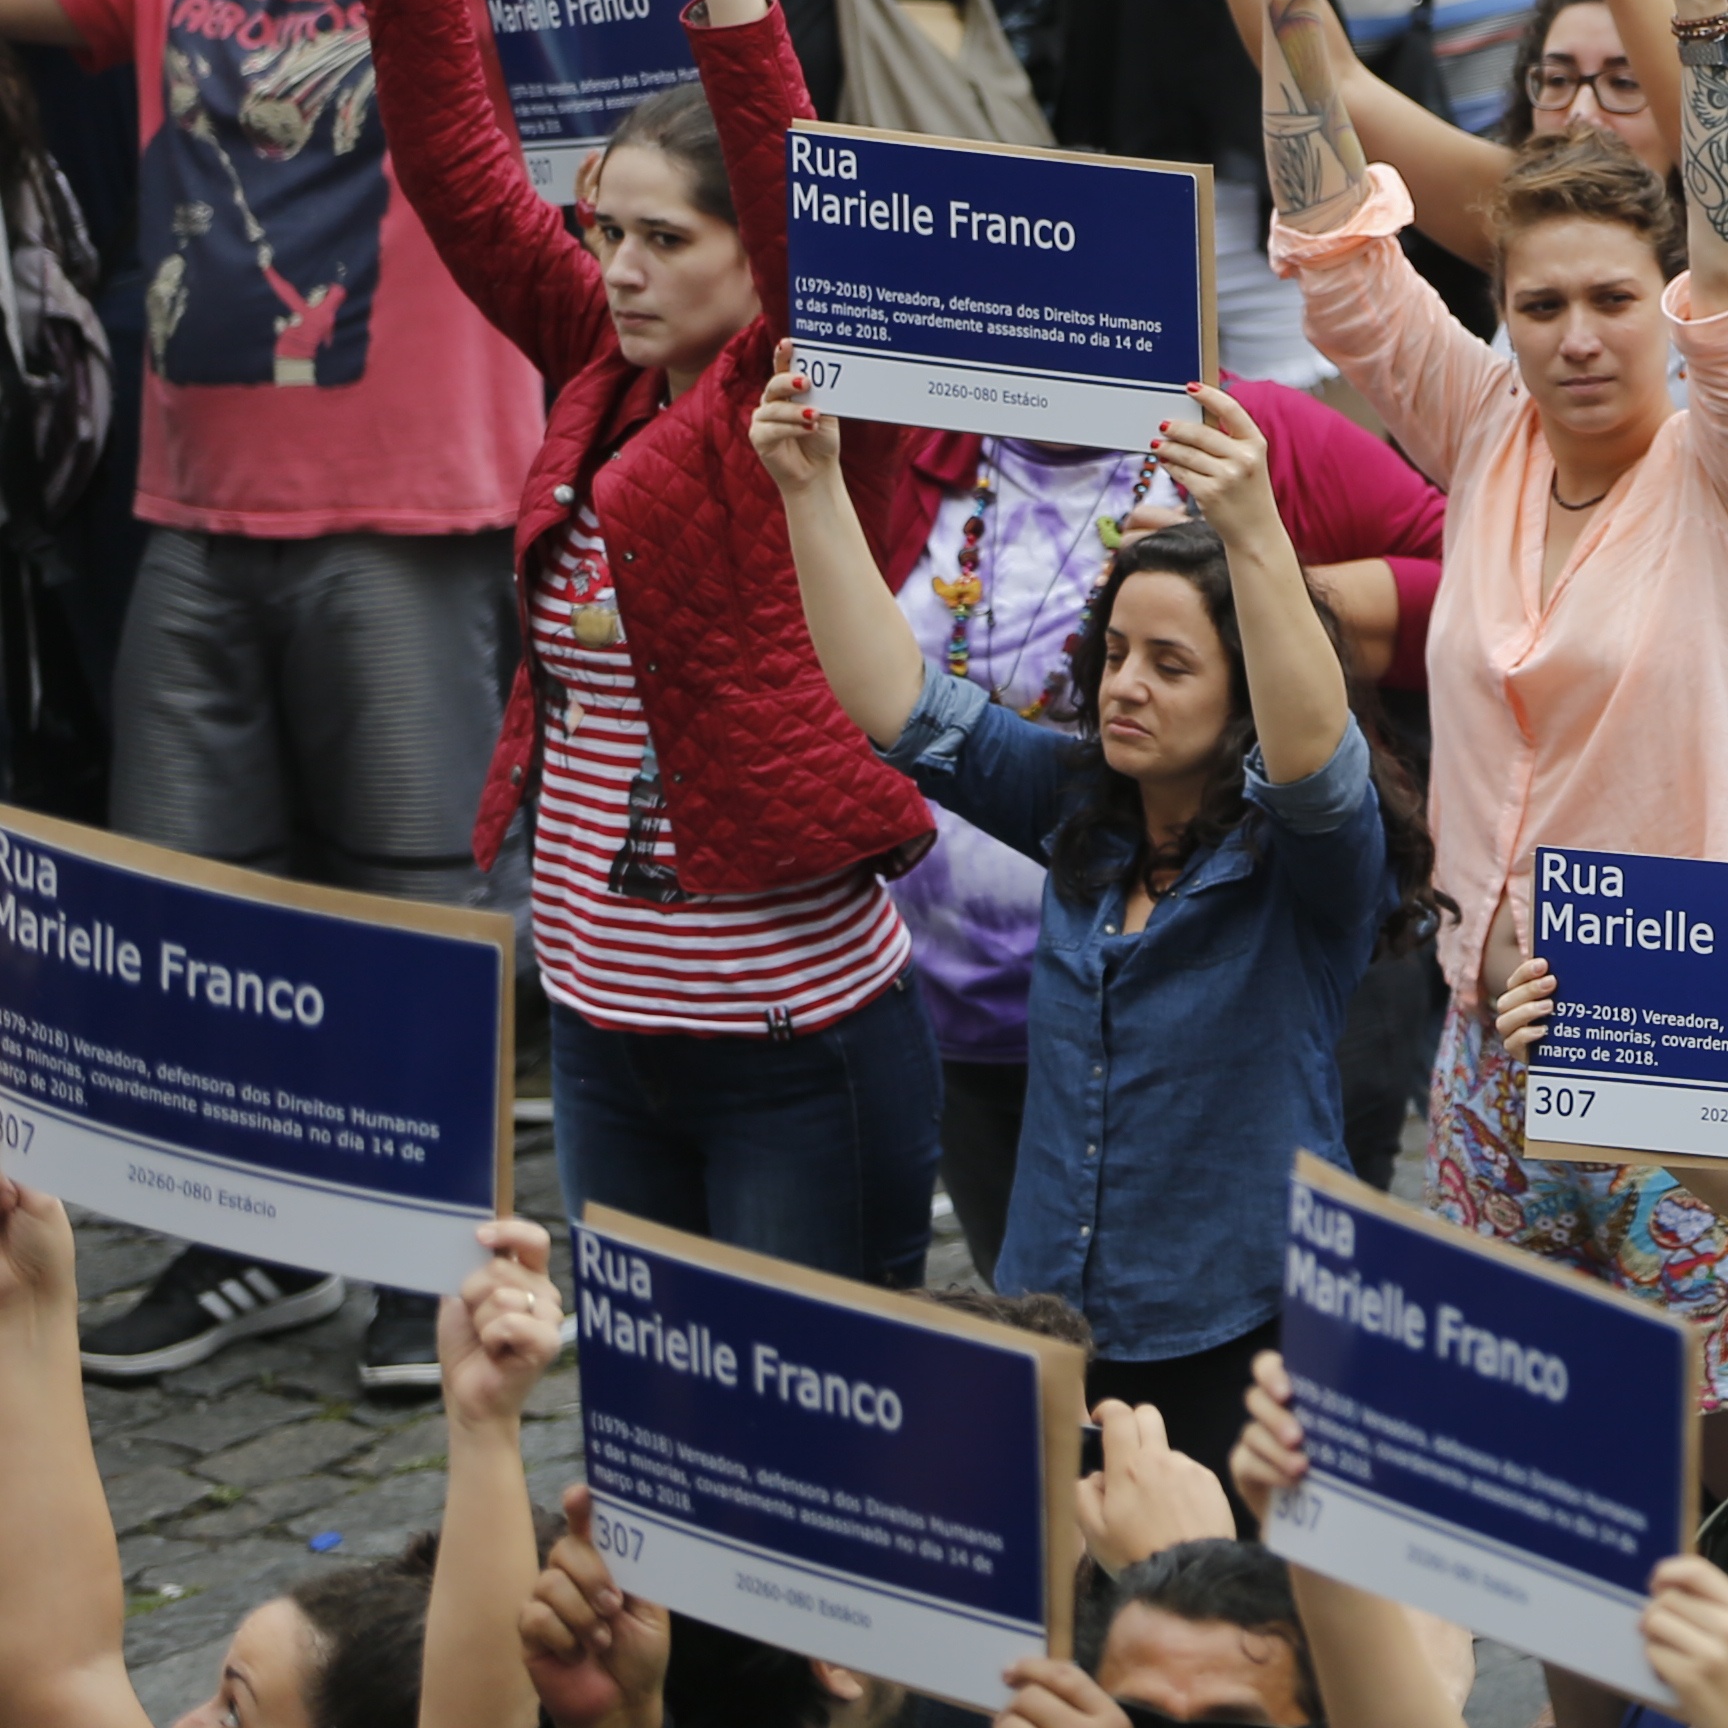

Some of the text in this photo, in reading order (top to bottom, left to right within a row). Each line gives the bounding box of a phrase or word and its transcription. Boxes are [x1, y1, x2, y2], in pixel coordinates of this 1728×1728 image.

[792, 136, 857, 179] Rua
[793, 182, 1075, 251] Marielle Franco
[795, 276, 1162, 333] (1979-2018) Vereadora, defensora dos Direitos Humanos
[795, 298, 1152, 352] e das minorias, covardemente assassinada no dia 14 de
[796, 318, 891, 341] março de 2018.
[928, 381, 1048, 408] 20260-080 Estácio
[1543, 853, 1623, 897] Rua
[1542, 902, 1713, 954] Marielle
[1536, 1087, 1595, 1117] 307
